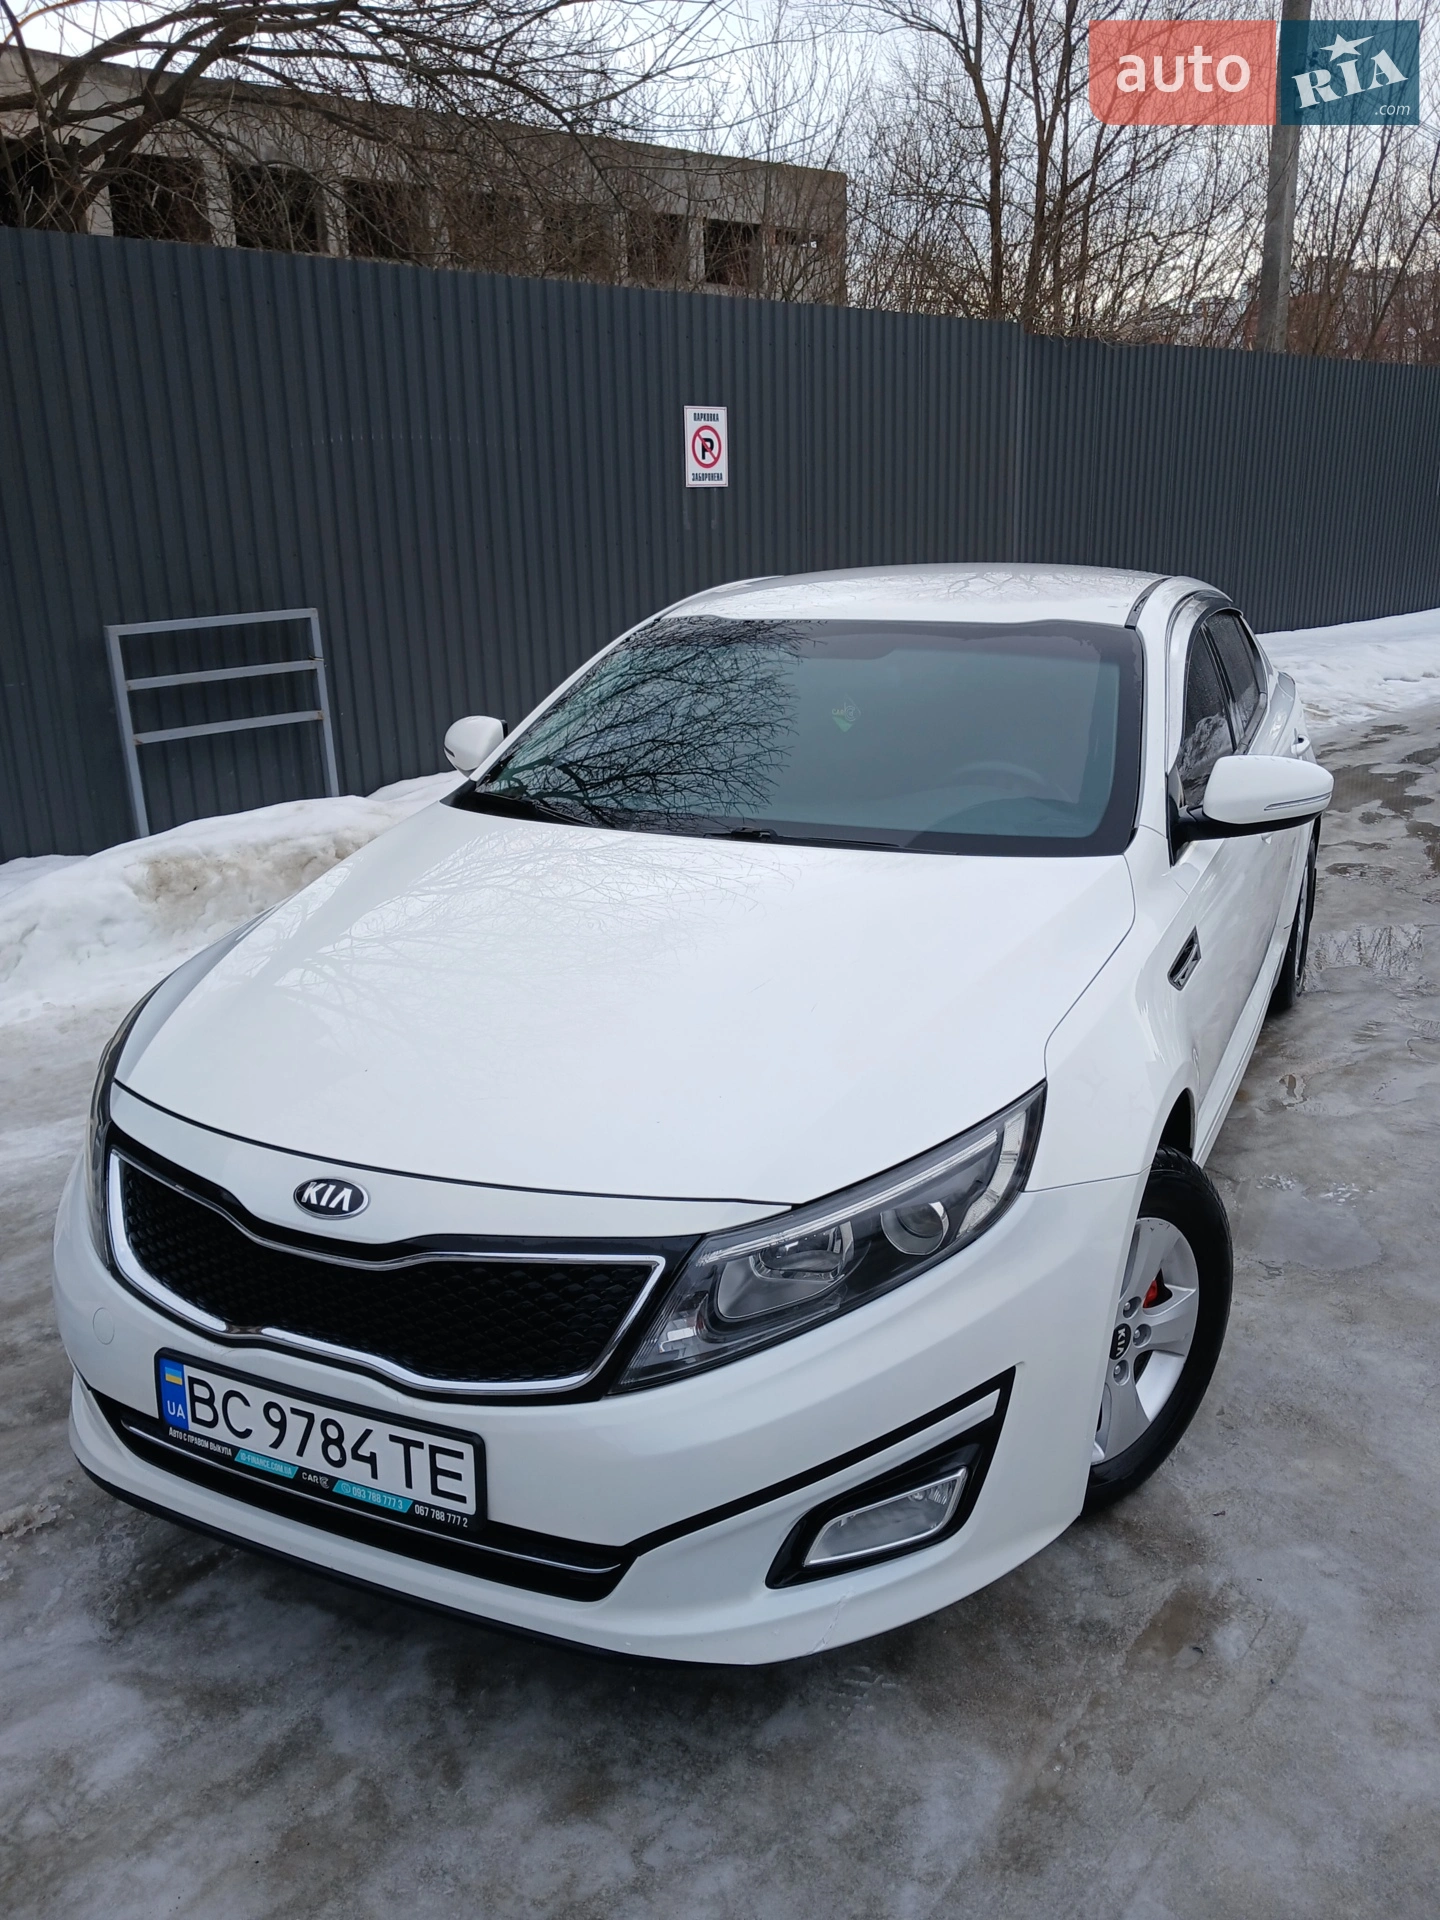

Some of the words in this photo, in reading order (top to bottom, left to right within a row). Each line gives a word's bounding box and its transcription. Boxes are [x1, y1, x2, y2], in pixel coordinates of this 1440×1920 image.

[694, 413, 719, 422] ПАРКОВКА
[692, 473, 723, 481] ЗАБОРОНЕНА
[301, 1182, 352, 1211] KIA
[1115, 1328, 1126, 1357] KIA
[166, 1399, 186, 1420] UA
[188, 1375, 253, 1440] BC
[262, 1400, 379, 1481] 9784
[389, 1433, 468, 1504] TE
[352, 1486, 366, 1499] 093
[367, 1489, 381, 1504] 788
[382, 1493, 397, 1507] 777
[397, 1499, 403, 1510] 3
[414, 1504, 429, 1518] 067
[431, 1508, 446, 1523] 788
[446, 1512, 461, 1527] 777
[462, 1517, 468, 1528] 2
